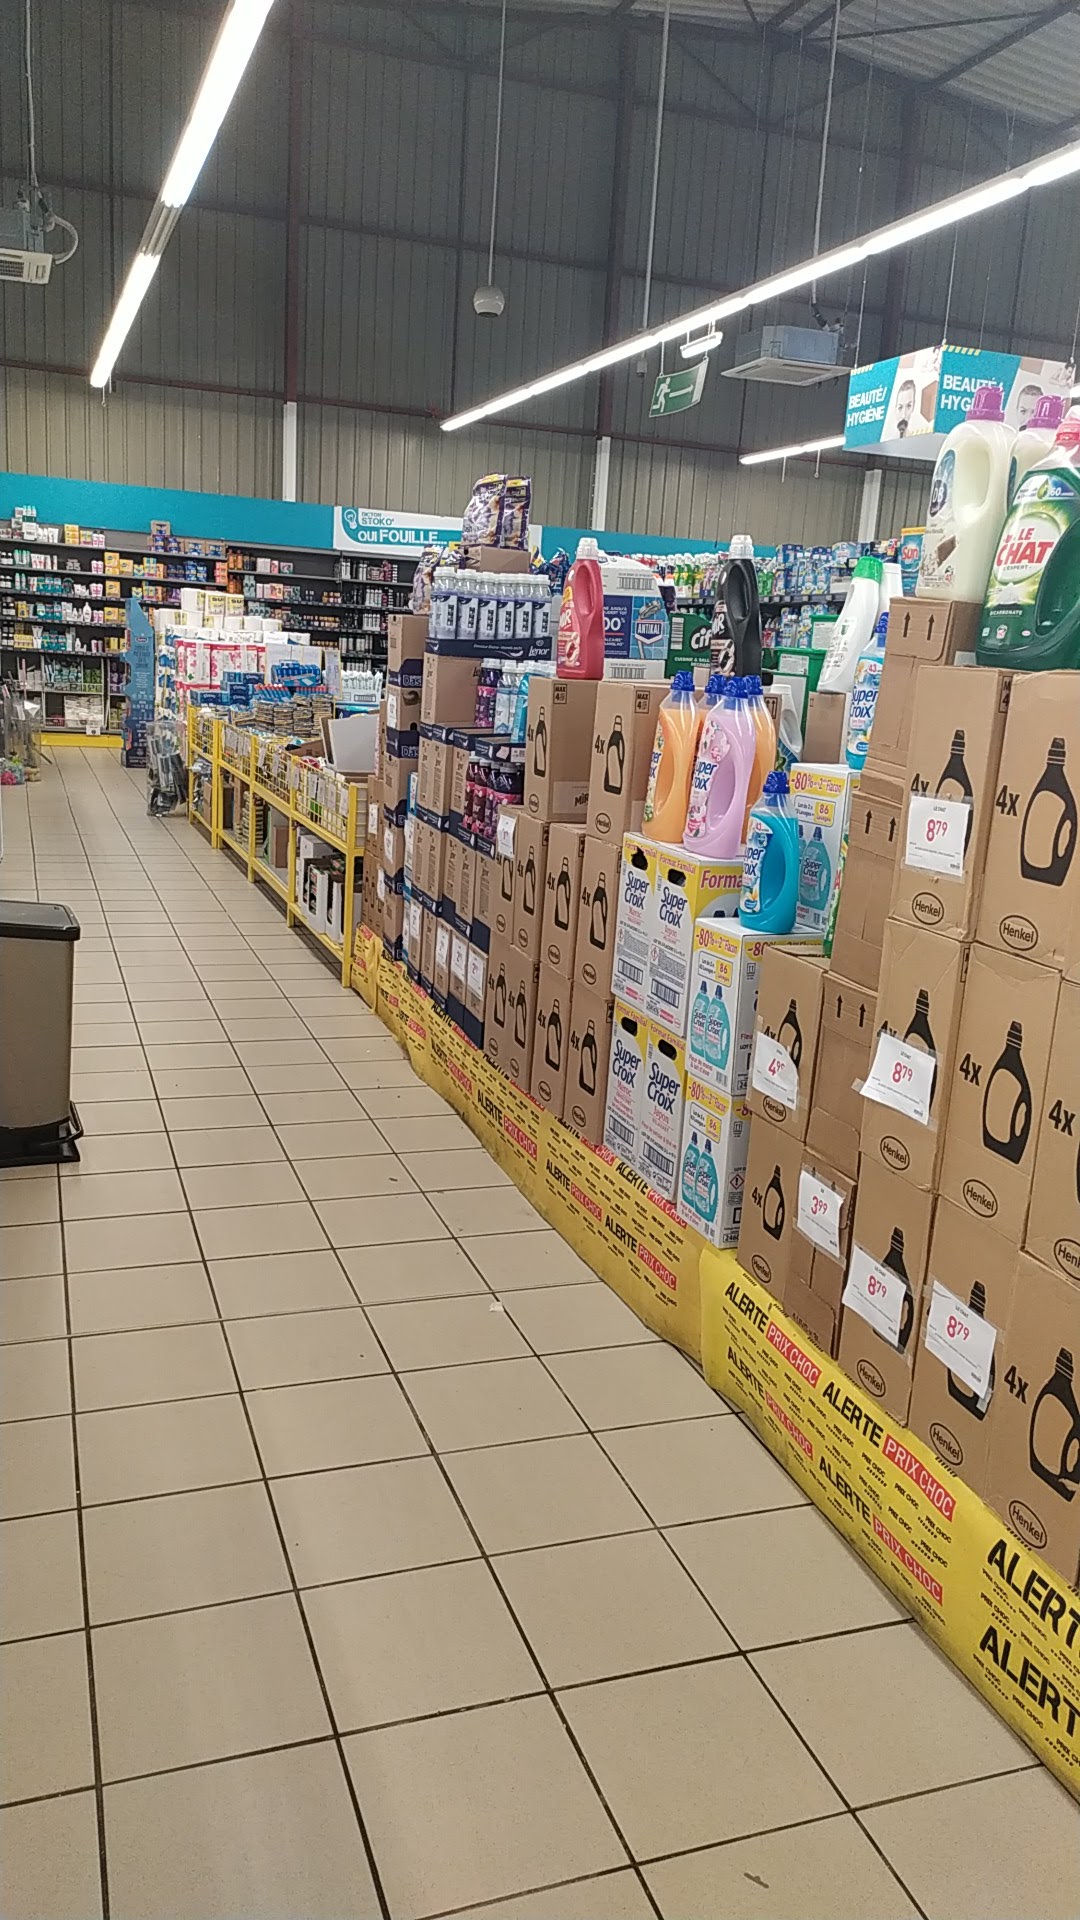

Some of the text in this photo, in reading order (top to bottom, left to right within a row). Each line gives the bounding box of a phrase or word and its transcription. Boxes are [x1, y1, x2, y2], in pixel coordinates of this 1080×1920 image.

[849, 387, 887, 409] BEAUTÉ/
[846, 407, 884, 427] HYGIÈNE
[1018, 527, 1035, 541] LE
[902, 546, 918, 560] Sun
[996, 541, 1055, 567] CHAT
[637, 622, 660, 635] ANTIKAL
[691, 628, 712, 649] Cif
[529, 645, 550, 657] Lenor
[868, 663, 877, 674] 43
[594, 734, 604, 755] 4x
[819, 804, 829, 815] 86
[995, 785, 1020, 817] 4x
[625, 871, 650, 894] Super
[701, 870, 742, 889] Forma
[582, 886, 591, 907] 4x
[624, 889, 645, 911] Croix
[661, 886, 688, 912] Super
[659, 903, 681, 929] Croix
[914, 899, 941, 918] Henkel
[1002, 924, 1034, 943] Henkel
[719, 963, 728, 974] 86
[537, 1008, 547, 1029] 4x
[693, 1008, 706, 1021] Supe
[570, 1030, 580, 1050] 4x
[614, 1039, 642, 1069] Super
[612, 1059, 637, 1088] Croix
[649, 1062, 680, 1096] Super
[892, 1061, 913, 1083] 879
[959, 1053, 981, 1086] 4x
[647, 1082, 675, 1115] Croix
[765, 1101, 786, 1118] Henkel
[477, 1089, 503, 1126] ALERTE
[503, 1117, 519, 1142] PRIX
[518, 1131, 537, 1158] CHOC
[1048, 1099, 1076, 1136] 4x
[883, 1143, 907, 1164] Henkel
[546, 1159, 602, 1219] ALERTE PRIX CHOC
[751, 1186, 763, 1208] 4x
[965, 1185, 995, 1212] Henkel
[811, 1196, 828, 1216] 399
[605, 1215, 676, 1289] ALERTE PRIX CHOC
[753, 1259, 770, 1277] Henkel
[867, 1275, 887, 1298] 879
[725, 1281, 769, 1334] ALERTE
[768, 1324, 789, 1356] PRIX
[789, 1348, 819, 1385] CHOC
[946, 1315, 970, 1341] 879
[728, 1346, 766, 1400] ALERTE
[859, 1363, 884, 1393] Henkel
[1004, 1365, 1030, 1405] 4x
[822, 1381, 953, 1517] ALERTE PRIX CHOC
[932, 1426, 961, 1460] Henkel
[819, 1456, 941, 1600] ALERTE PRIX CHOC
[1012, 1503, 1046, 1545] Henkel
[988, 1538, 1080, 1649] ALERT
[980, 1625, 1080, 1738] ALERT
[1056, 1738, 1071, 1755] PRIX
